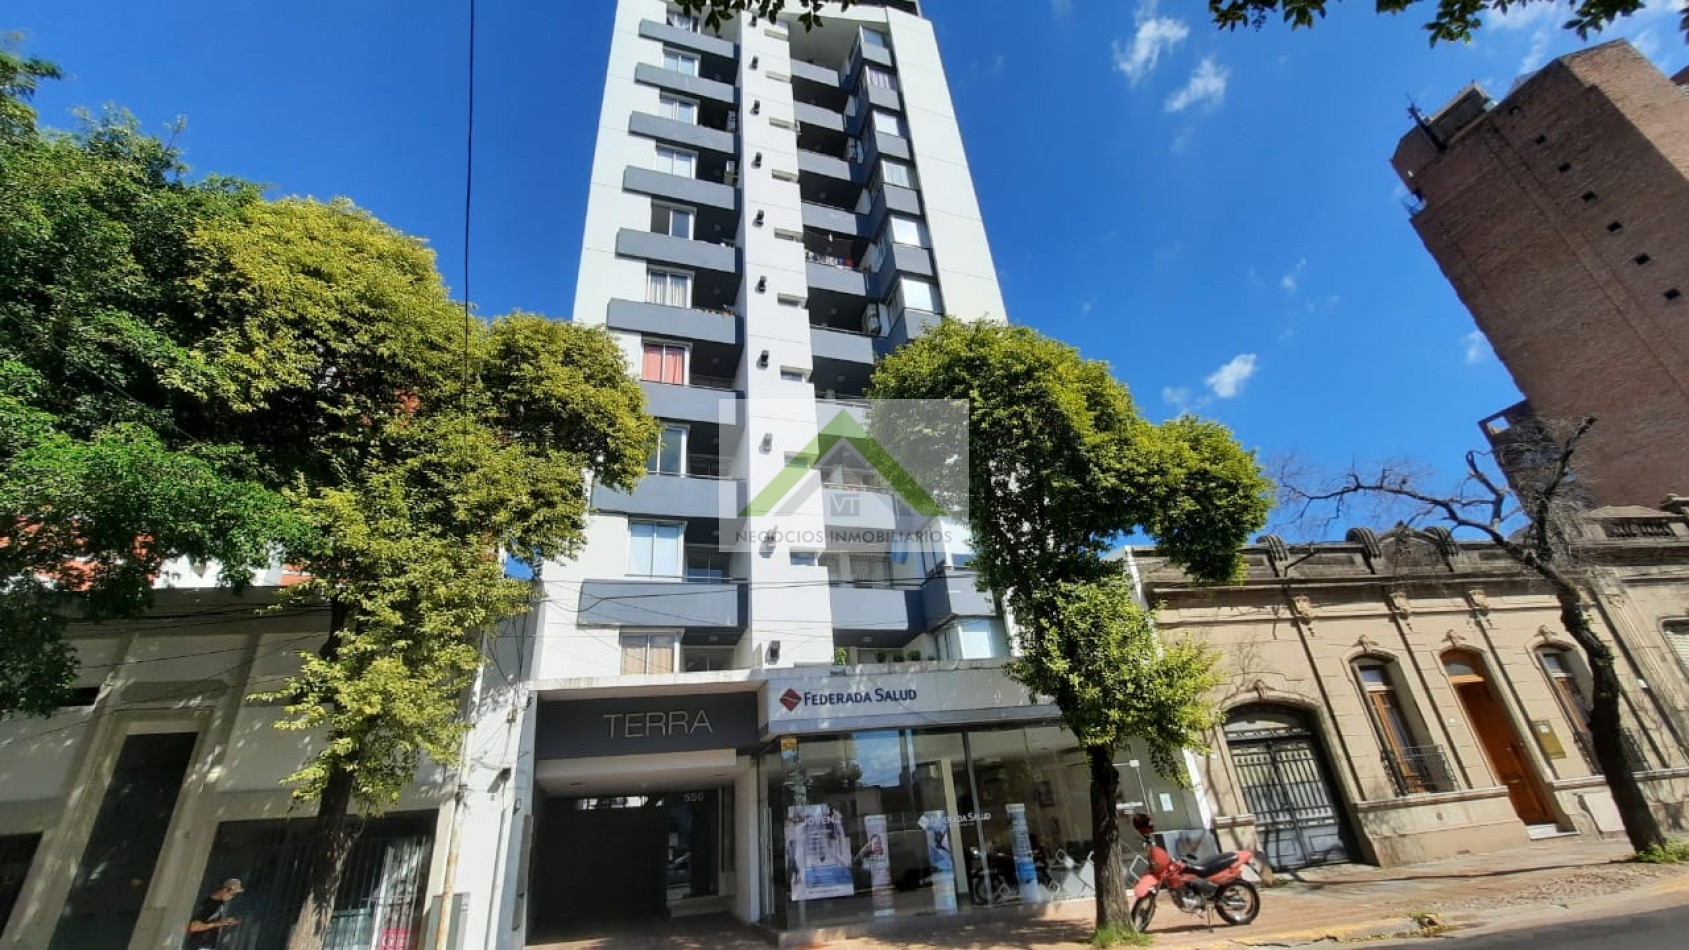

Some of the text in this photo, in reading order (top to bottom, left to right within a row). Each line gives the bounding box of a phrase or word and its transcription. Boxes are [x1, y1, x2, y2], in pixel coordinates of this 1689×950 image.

[804, 688, 917, 706] FEDERADA SALUD
[602, 709, 713, 739] TERRA
